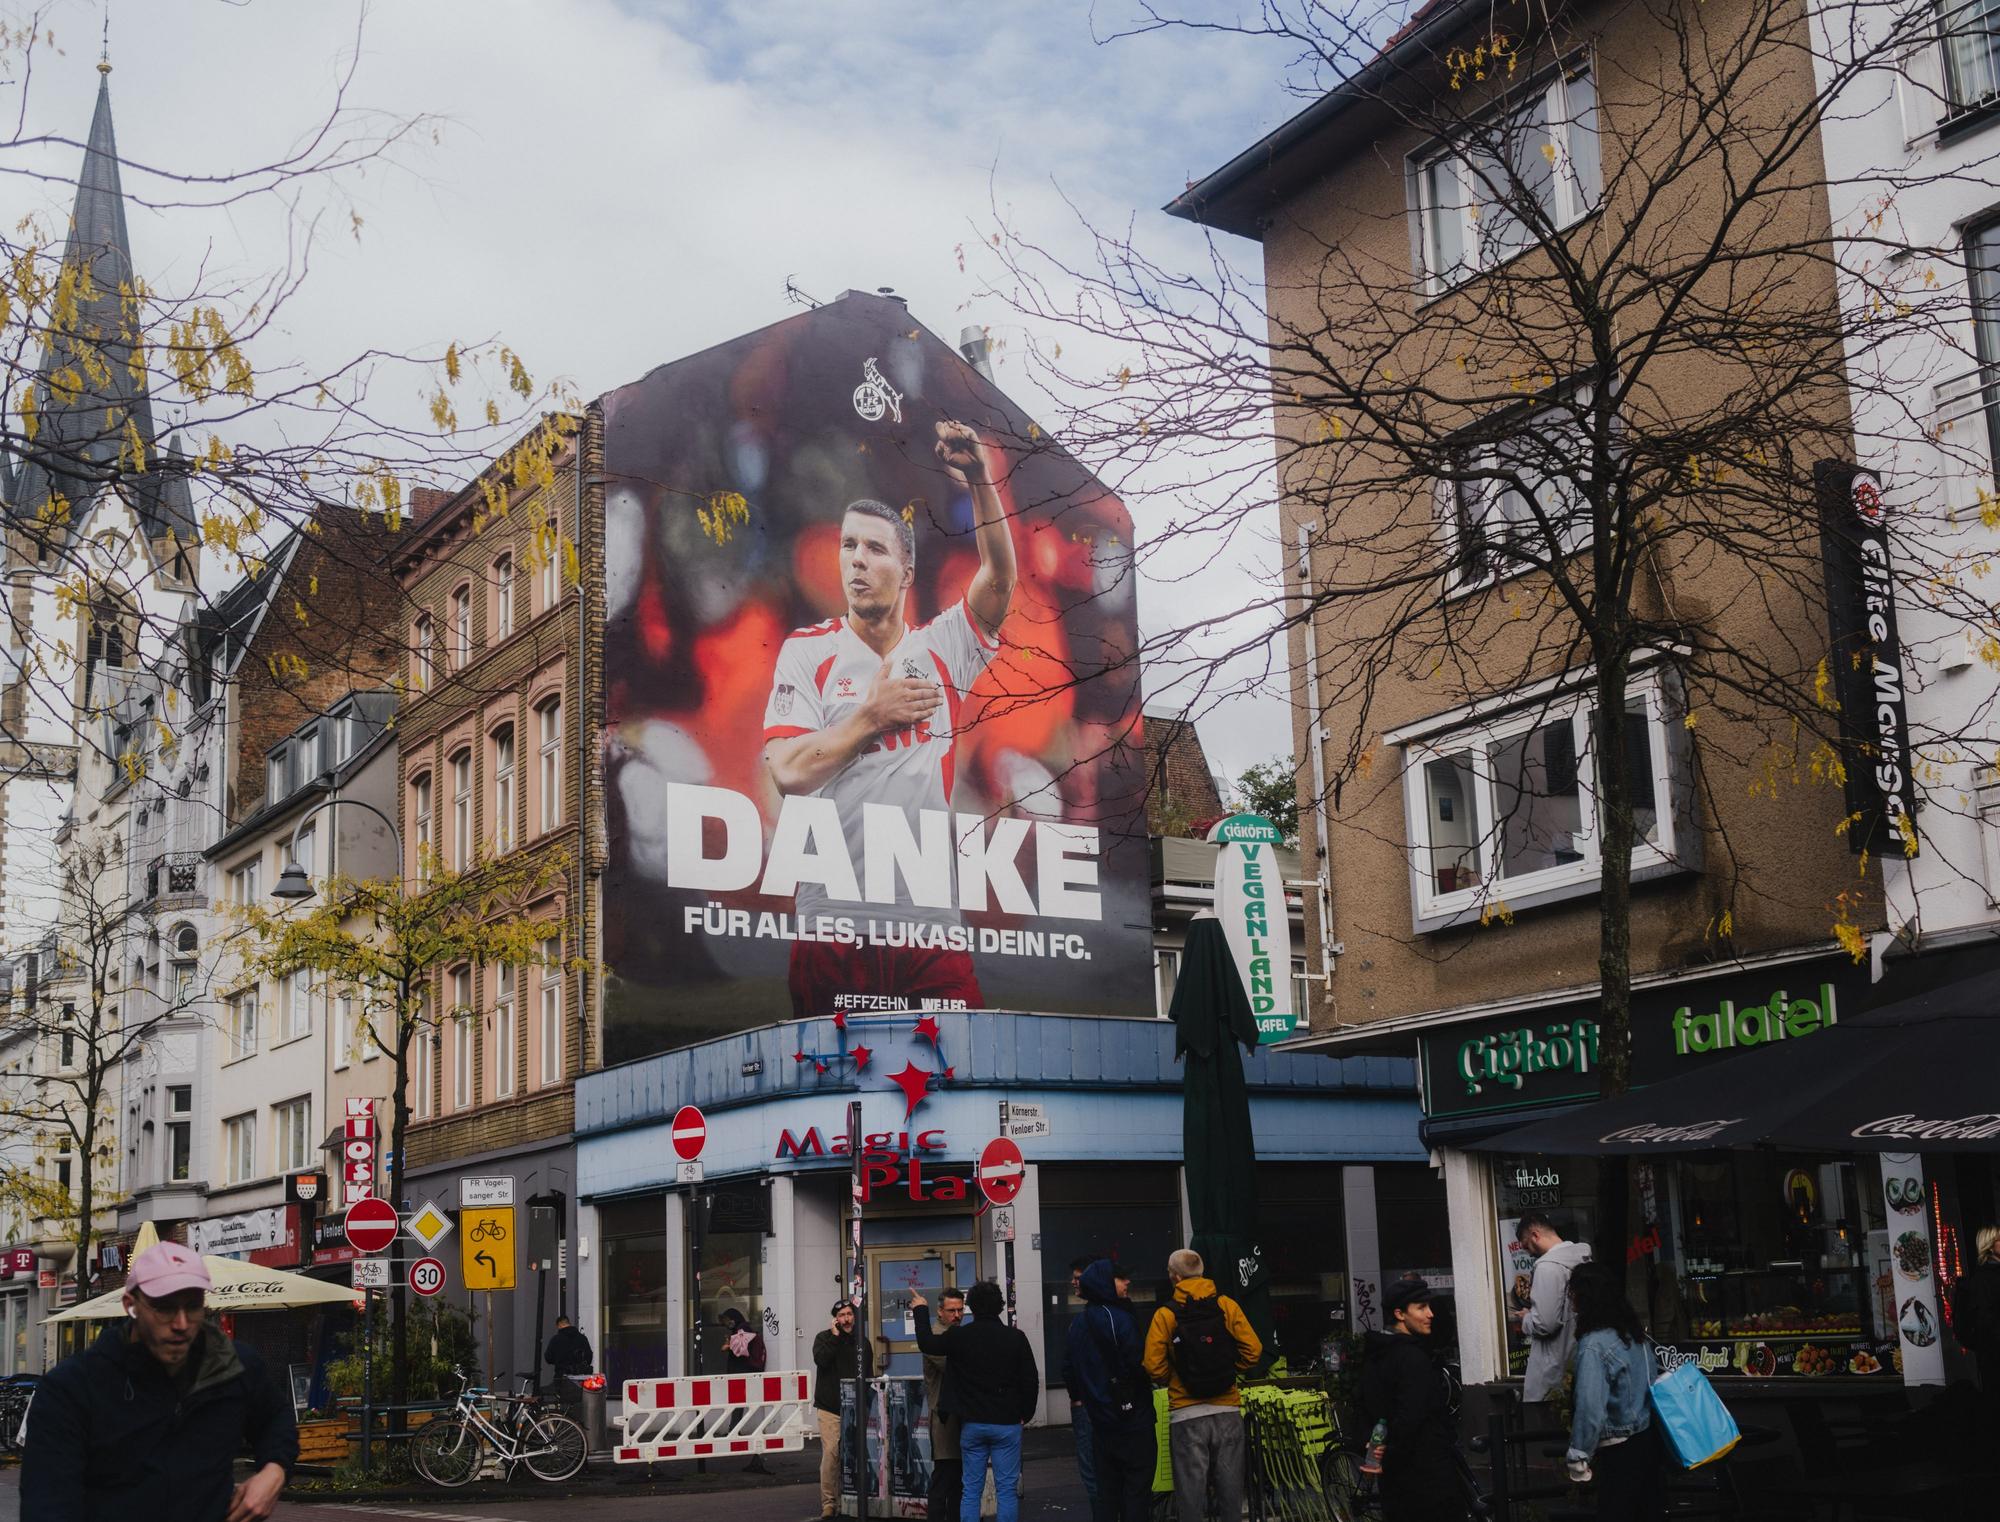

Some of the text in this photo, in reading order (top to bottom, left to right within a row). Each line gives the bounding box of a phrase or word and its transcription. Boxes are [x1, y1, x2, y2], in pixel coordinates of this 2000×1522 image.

[667, 782, 1102, 921] DANKE
[684, 901, 1092, 961] FÜR ALLES, LUKAS! DEIN FC.
[1239, 844, 1275, 1014] VEGANLAND
[833, 993, 909, 1011] #EFFZEHN
[1256, 1018, 1290, 1033] LAFEL
[1672, 983, 1838, 1056] falafel
[1457, 1017, 1601, 1097] Çiğköft
[1011, 1104, 1040, 1118] Körnerstr.
[1010, 1121, 1048, 1136] Venloer Str.
[346, 1098, 372, 1203] KIOSK
[775, 1126, 948, 1166] Magic
[470, 1179, 508, 1188] FR Vogel-
[1515, 1167, 1560, 1189] fritz-kola
[469, 1192, 494, 1200] sanger
[1520, 1190, 1559, 1206] OPEN
[416, 1268, 438, 1285] 30
